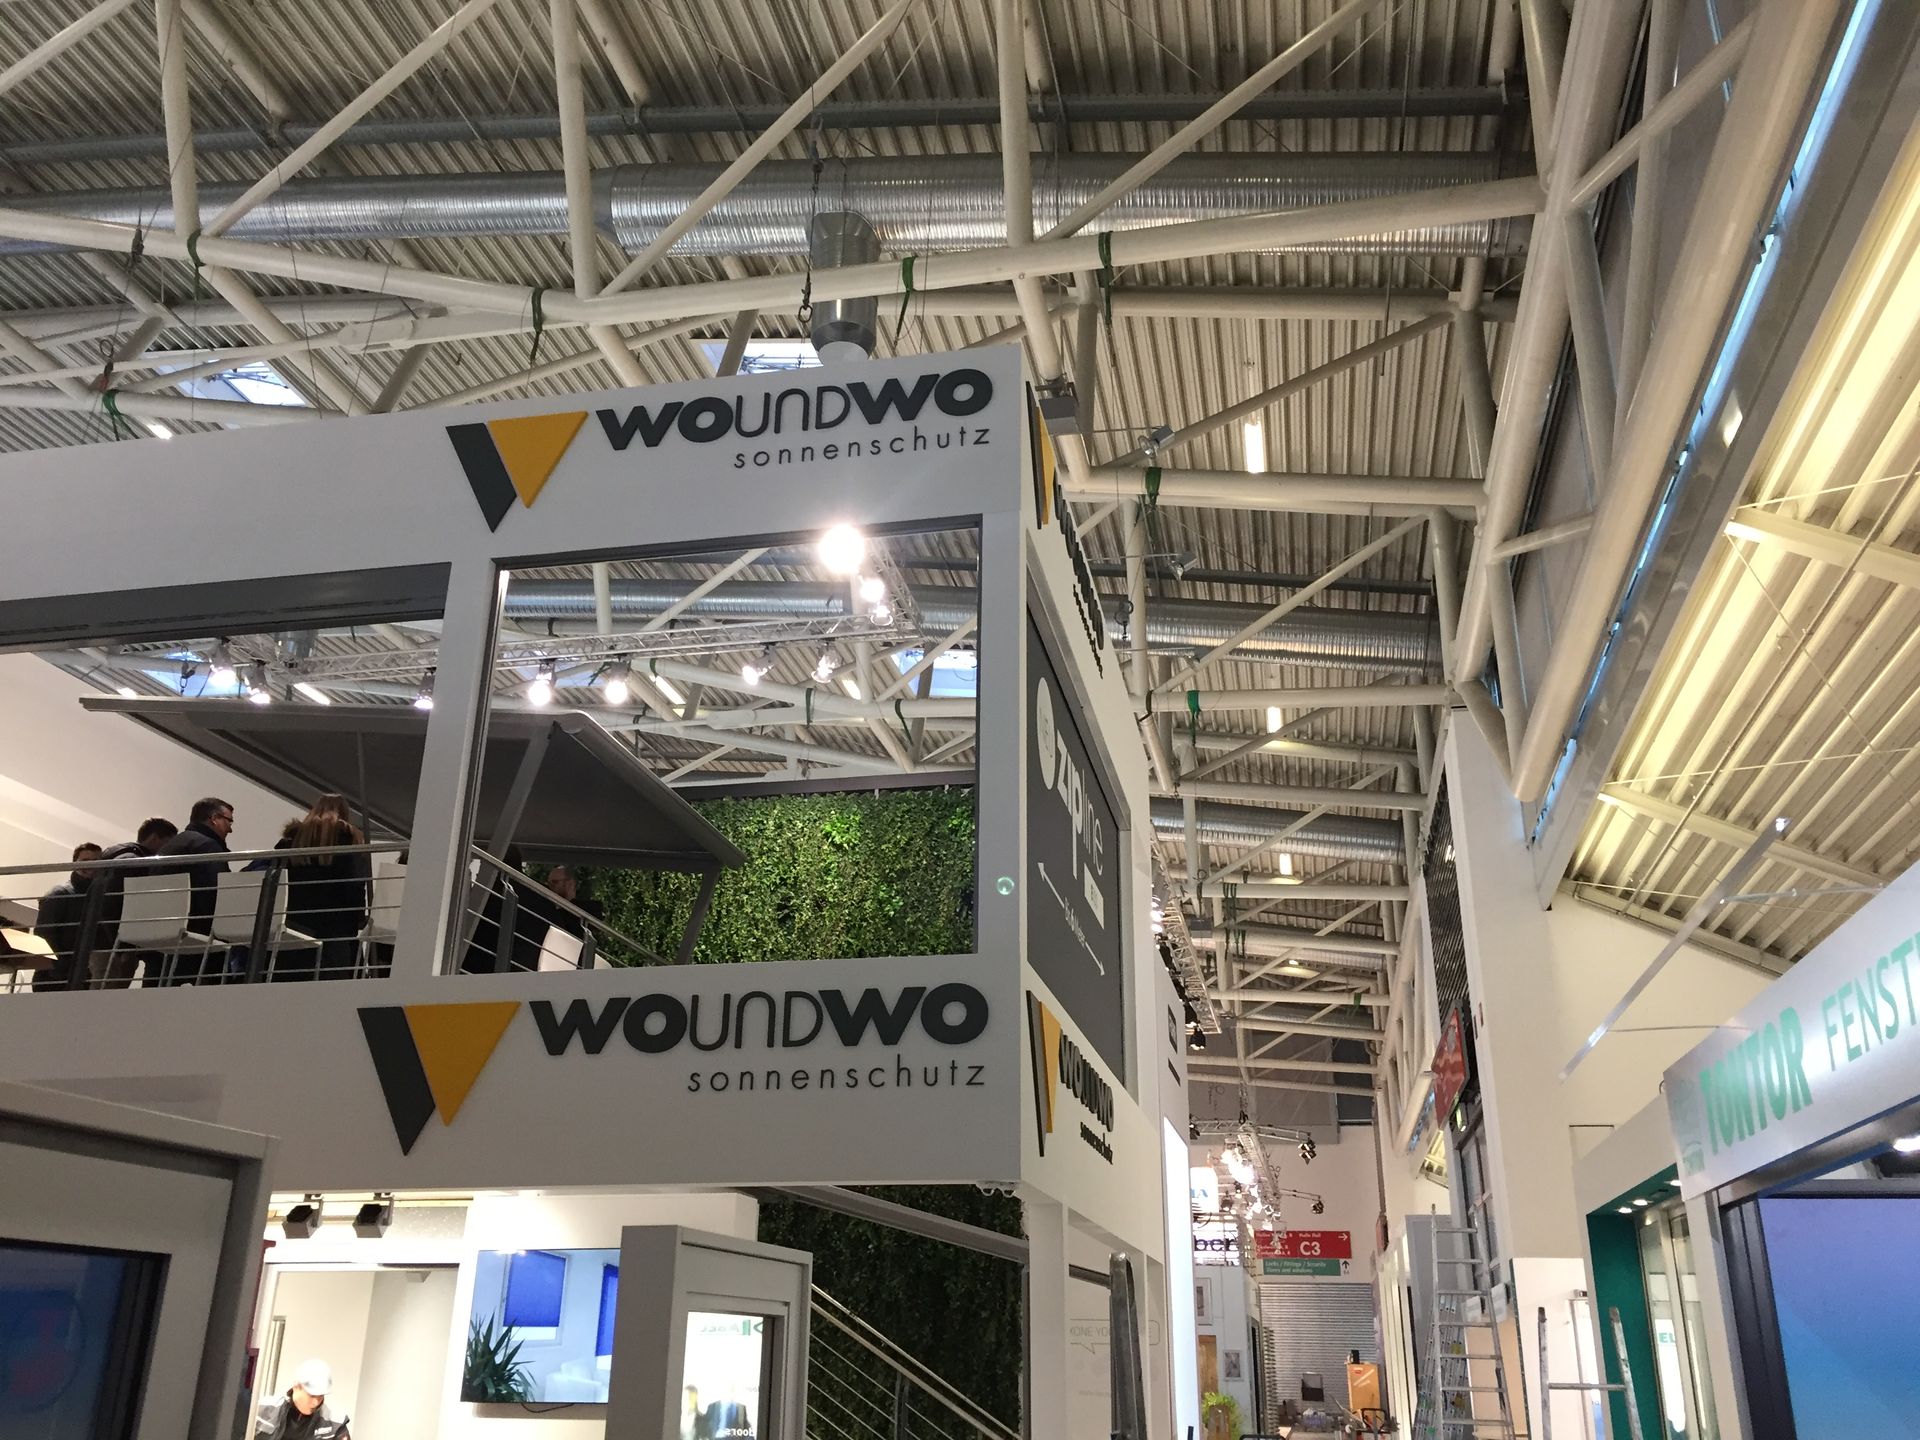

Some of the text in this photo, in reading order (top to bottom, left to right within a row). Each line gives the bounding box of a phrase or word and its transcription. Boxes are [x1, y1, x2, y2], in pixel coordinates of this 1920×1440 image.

[596, 368, 993, 451] WOUNDWO
[733, 426, 991, 469] sonnenschutz
[528, 982, 989, 1056] WOUNDWO
[1822, 931, 1920, 1072] FENST
[687, 1053, 986, 1092] sonnenschutz
[1300, 1241, 1321, 1256] C3
